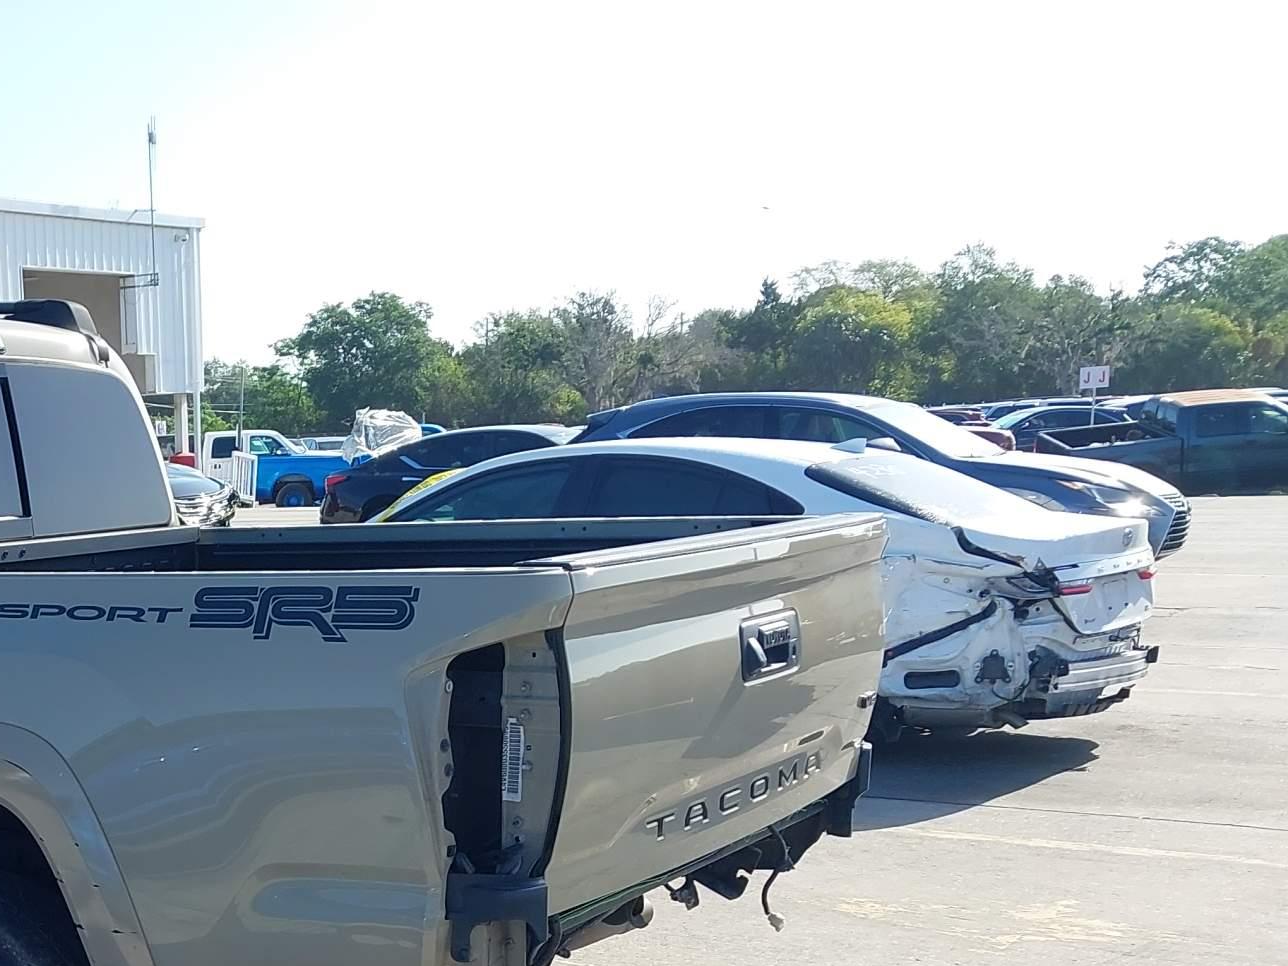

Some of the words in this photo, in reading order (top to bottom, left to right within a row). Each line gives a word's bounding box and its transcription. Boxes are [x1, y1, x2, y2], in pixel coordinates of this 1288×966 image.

[1083, 371, 1091, 384] J
[1098, 370, 1106, 383] J
[189, 586, 420, 642] SR5
[645, 753, 822, 841] TACOMA
